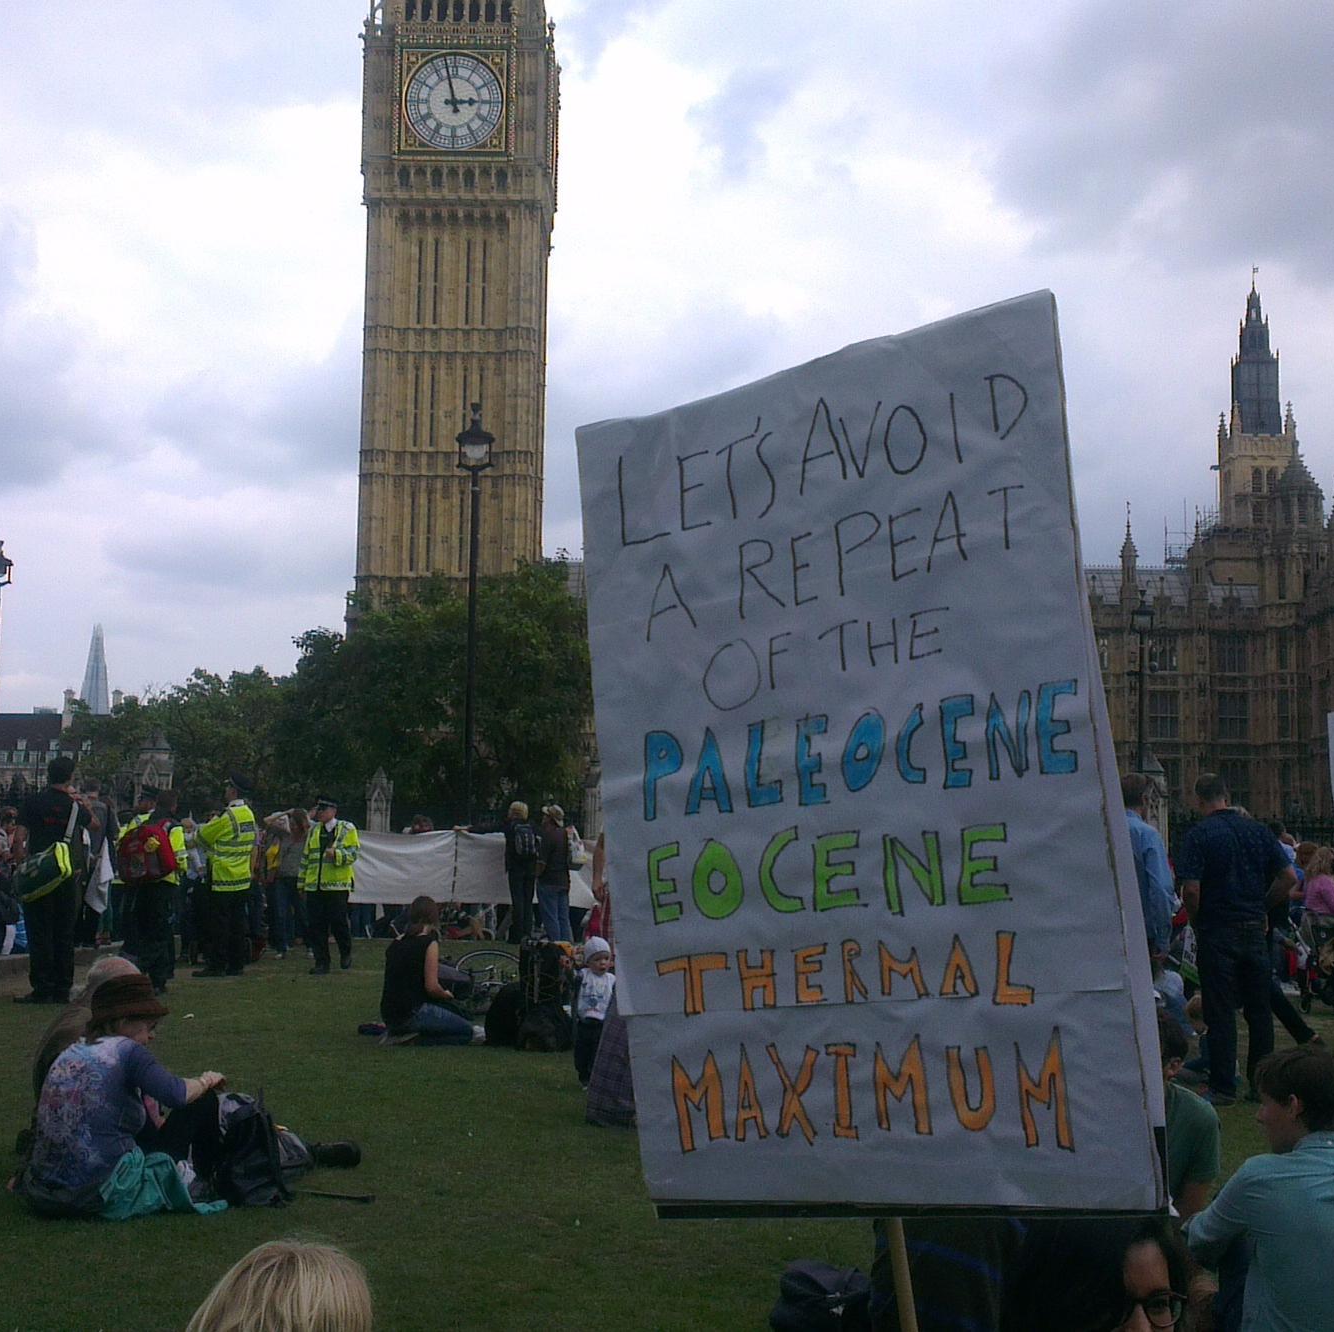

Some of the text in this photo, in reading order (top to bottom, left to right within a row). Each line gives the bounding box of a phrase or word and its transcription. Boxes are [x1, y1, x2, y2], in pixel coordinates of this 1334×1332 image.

[618, 373, 1029, 546] LET'S AVOID
[646, 485, 1025, 642] A REPEAT
[702, 606, 950, 711] OF THE
[643, 679, 1078, 820] PALEOCENE
[647, 822, 1013, 924] EOCENE
[655, 931, 1035, 1016] THERMAL
[671, 1026, 1076, 1154] MAXIMUM
